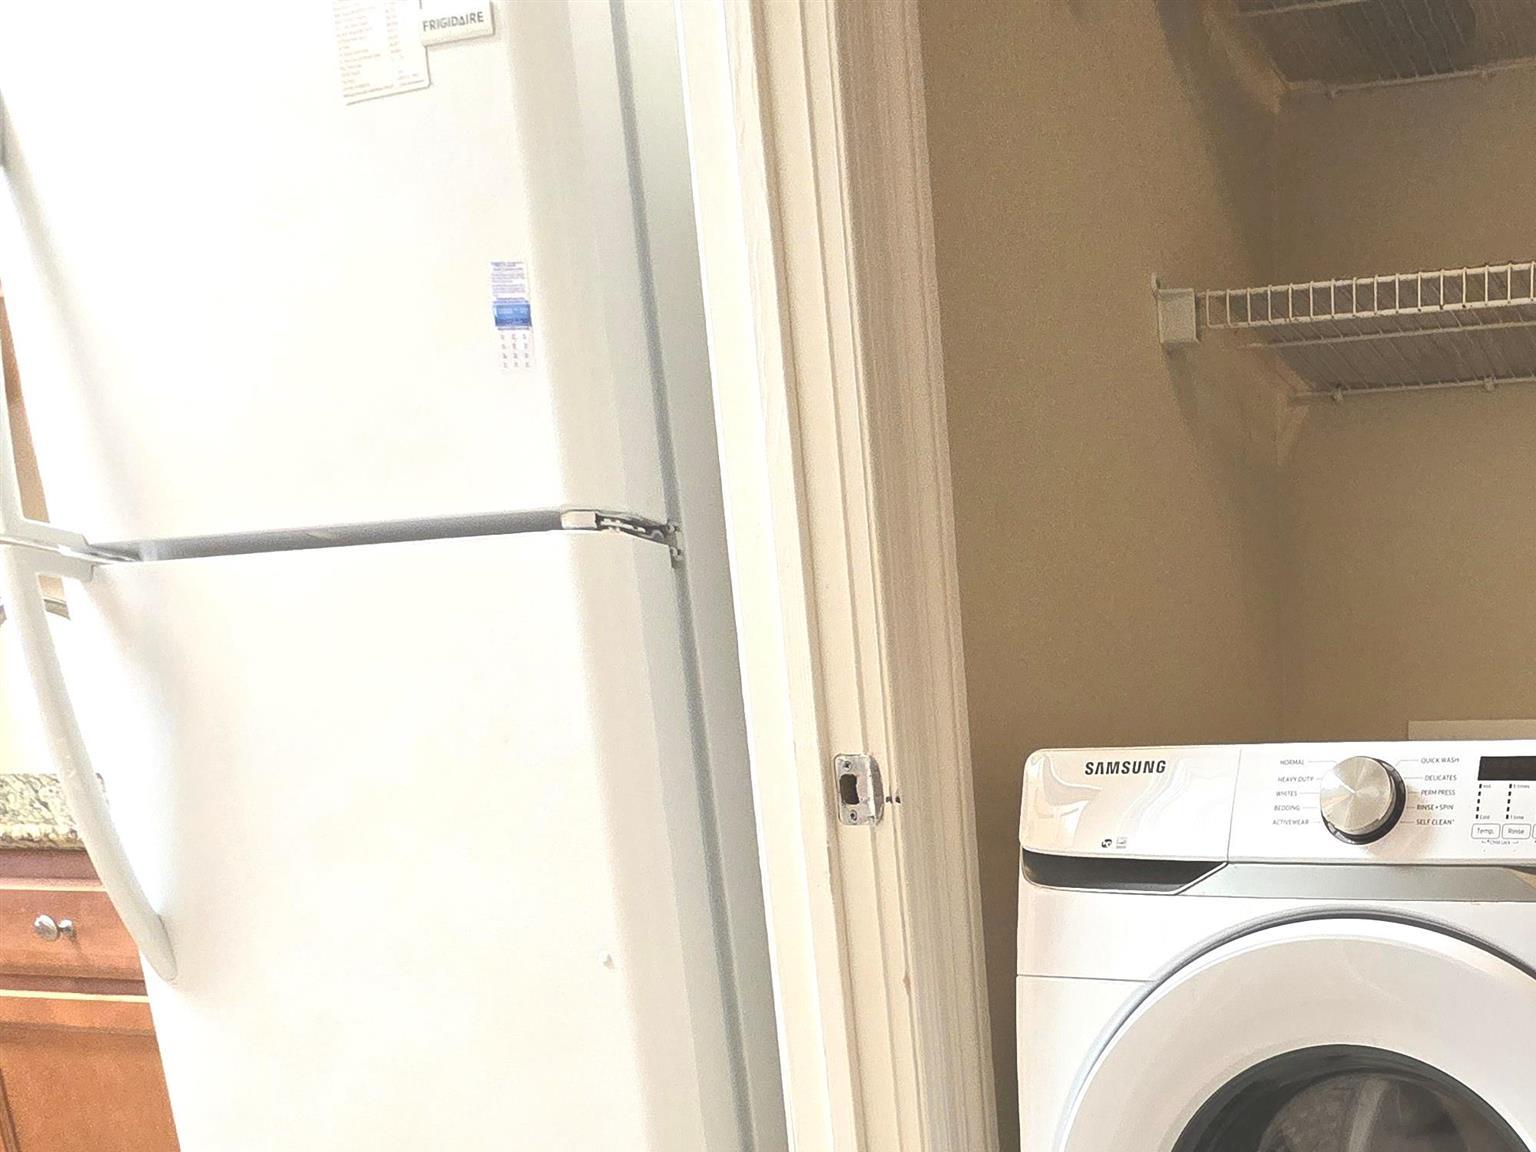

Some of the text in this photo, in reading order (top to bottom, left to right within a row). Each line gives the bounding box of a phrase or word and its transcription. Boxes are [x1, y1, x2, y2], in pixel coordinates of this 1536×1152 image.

[423, 11, 484, 32] FRIGIDAIRE
[1085, 760, 1166, 775] SAMSUNG
[1508, 826, 1525, 835] Rinse
